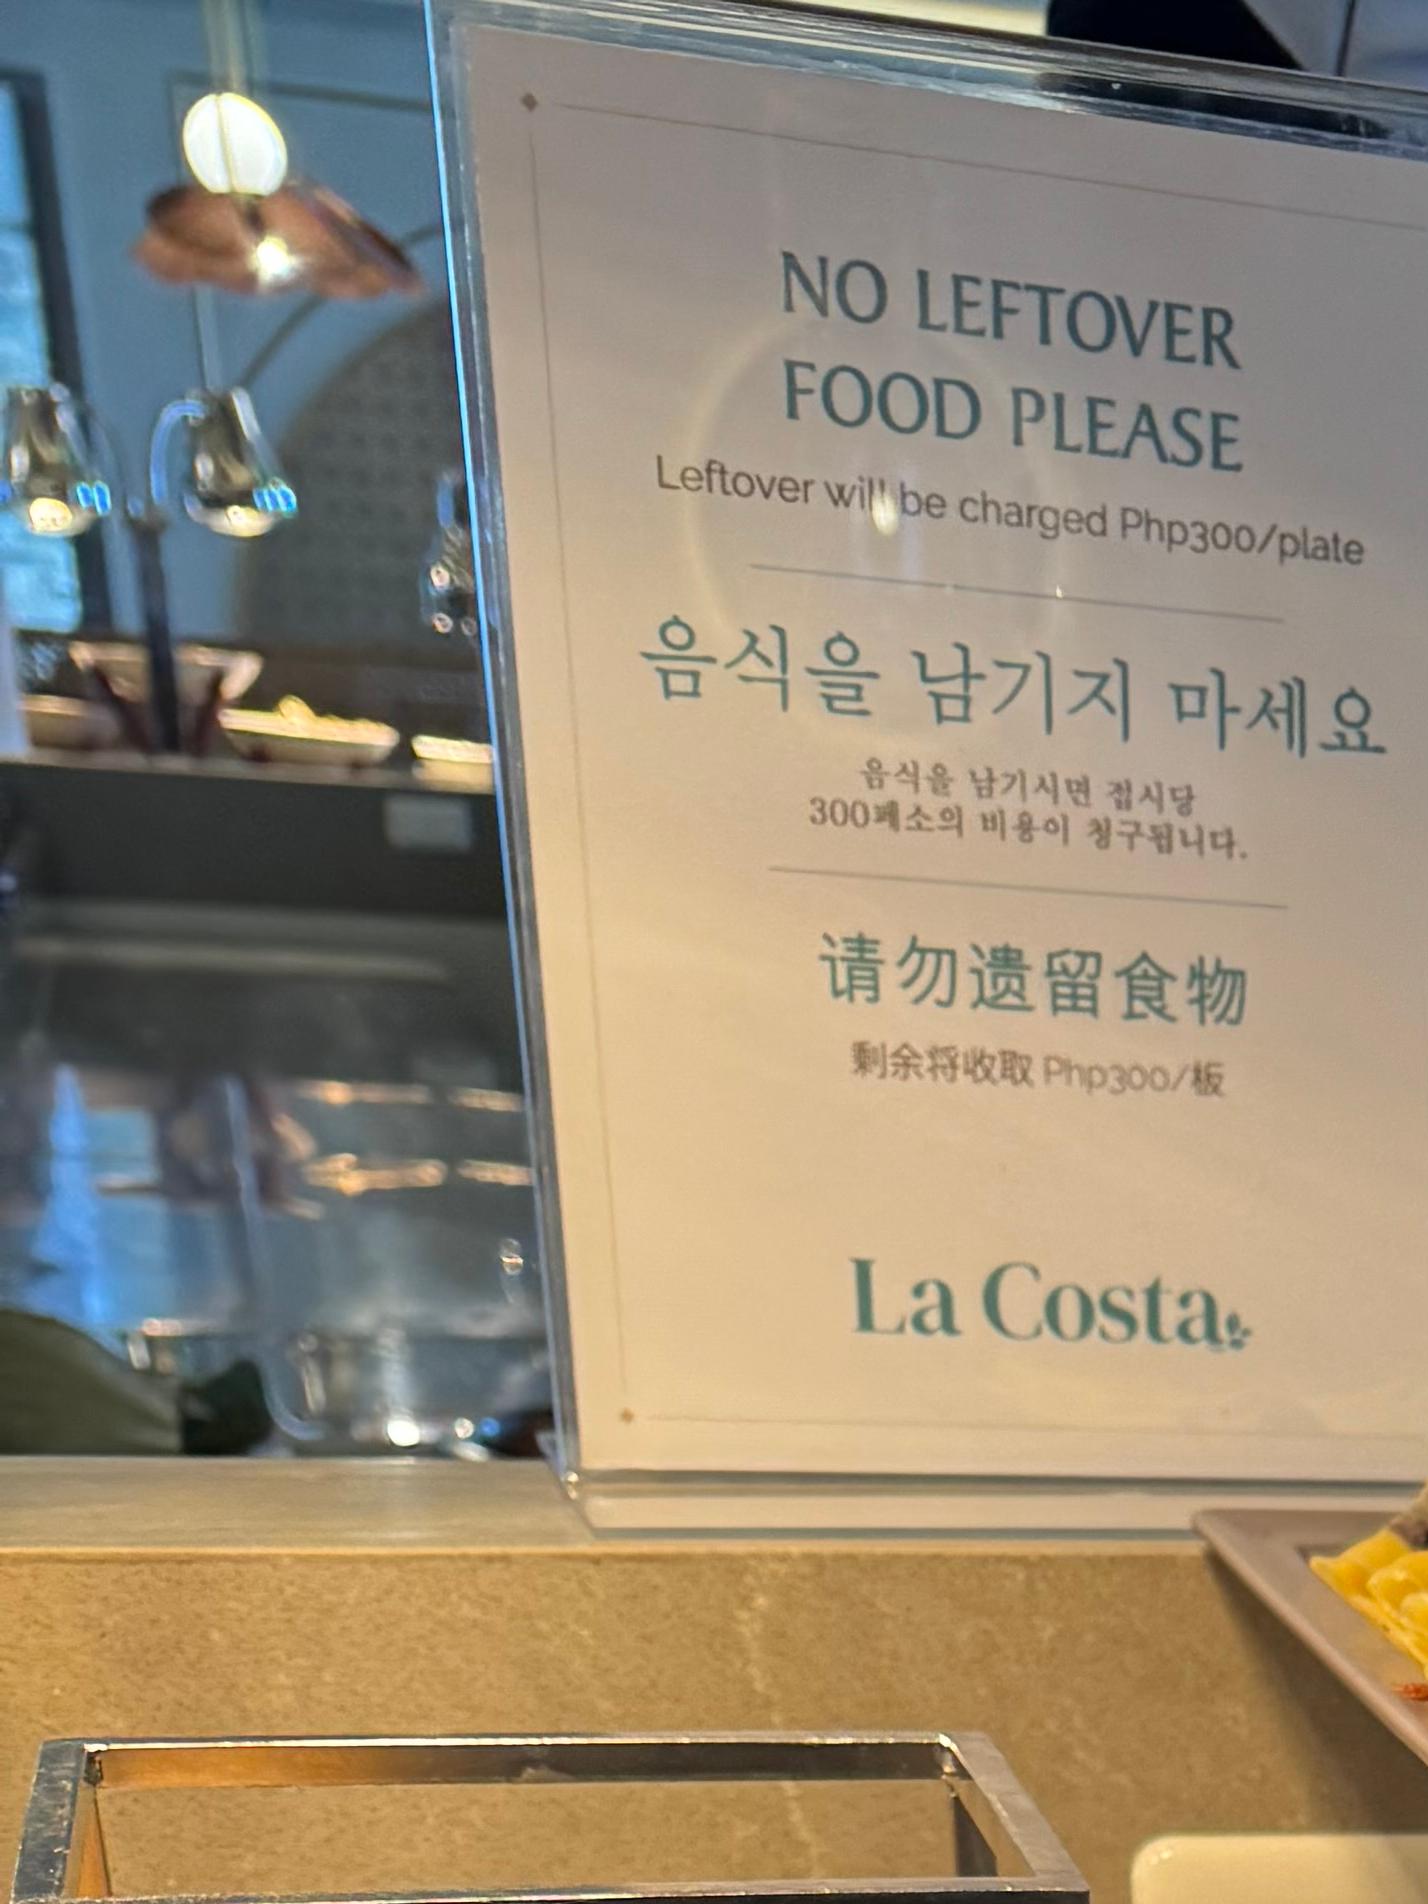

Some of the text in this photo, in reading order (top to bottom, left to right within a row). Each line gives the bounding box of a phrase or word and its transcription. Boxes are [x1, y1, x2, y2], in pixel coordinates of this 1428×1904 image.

[780, 249, 1243, 371] NO LEFTOVER
[782, 358, 1245, 473] FOOD PLEASE
[655, 454, 1366, 568] Leftover will be charged Php300/plate
[640, 613, 1389, 759] 음식을 남기지 마세요
[859, 756, 954, 795] 음식을
[969, 766, 1092, 807] 남기시면
[981, 811, 1070, 846] 비용이
[817, 932, 1249, 1028] 请勿遗留食物
[849, 1257, 1225, 1349] La Costa
